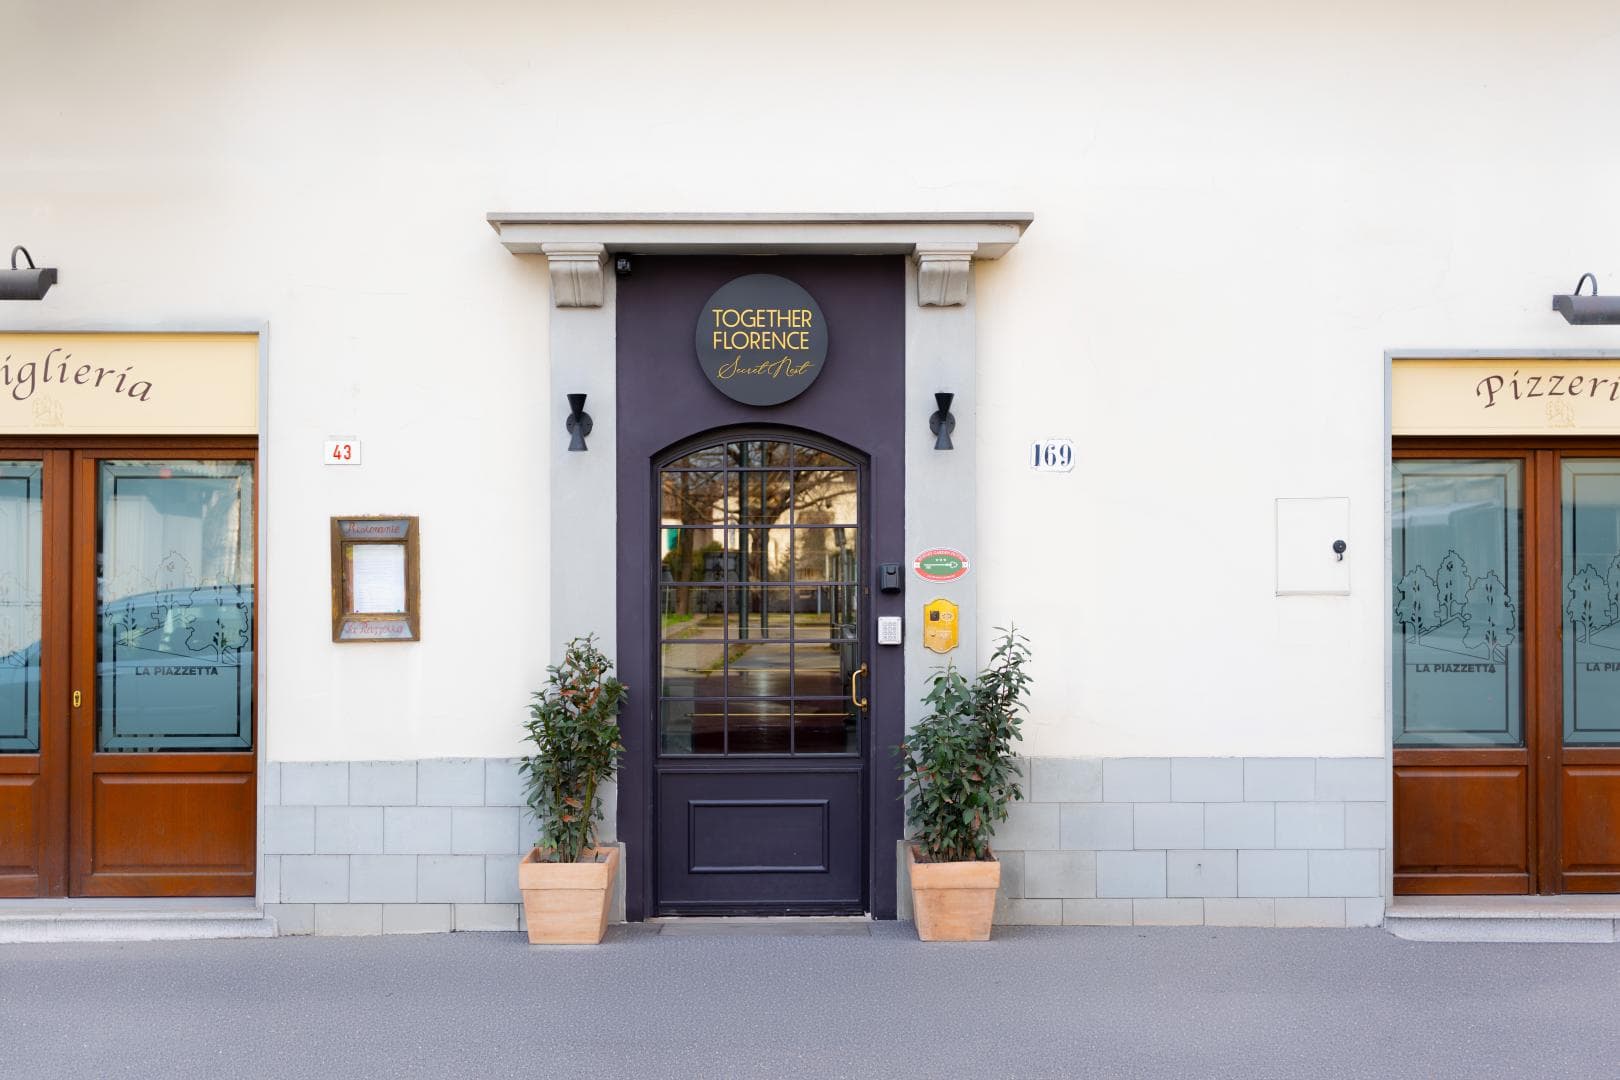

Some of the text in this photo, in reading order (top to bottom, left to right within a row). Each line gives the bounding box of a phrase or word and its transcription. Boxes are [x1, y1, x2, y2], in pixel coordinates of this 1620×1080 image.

[712, 308, 812, 328] TOGETHER
[713, 331, 810, 350] FLORENCE
[717, 355, 815, 380] Secret Nest
[333, 444, 352, 460] 43
[1033, 443, 1072, 467] 169
[135, 666, 219, 676] LA PIAZZETTA
[1415, 663, 1497, 673] LA PIAZZETTA
[1586, 662, 1600, 672] LA
